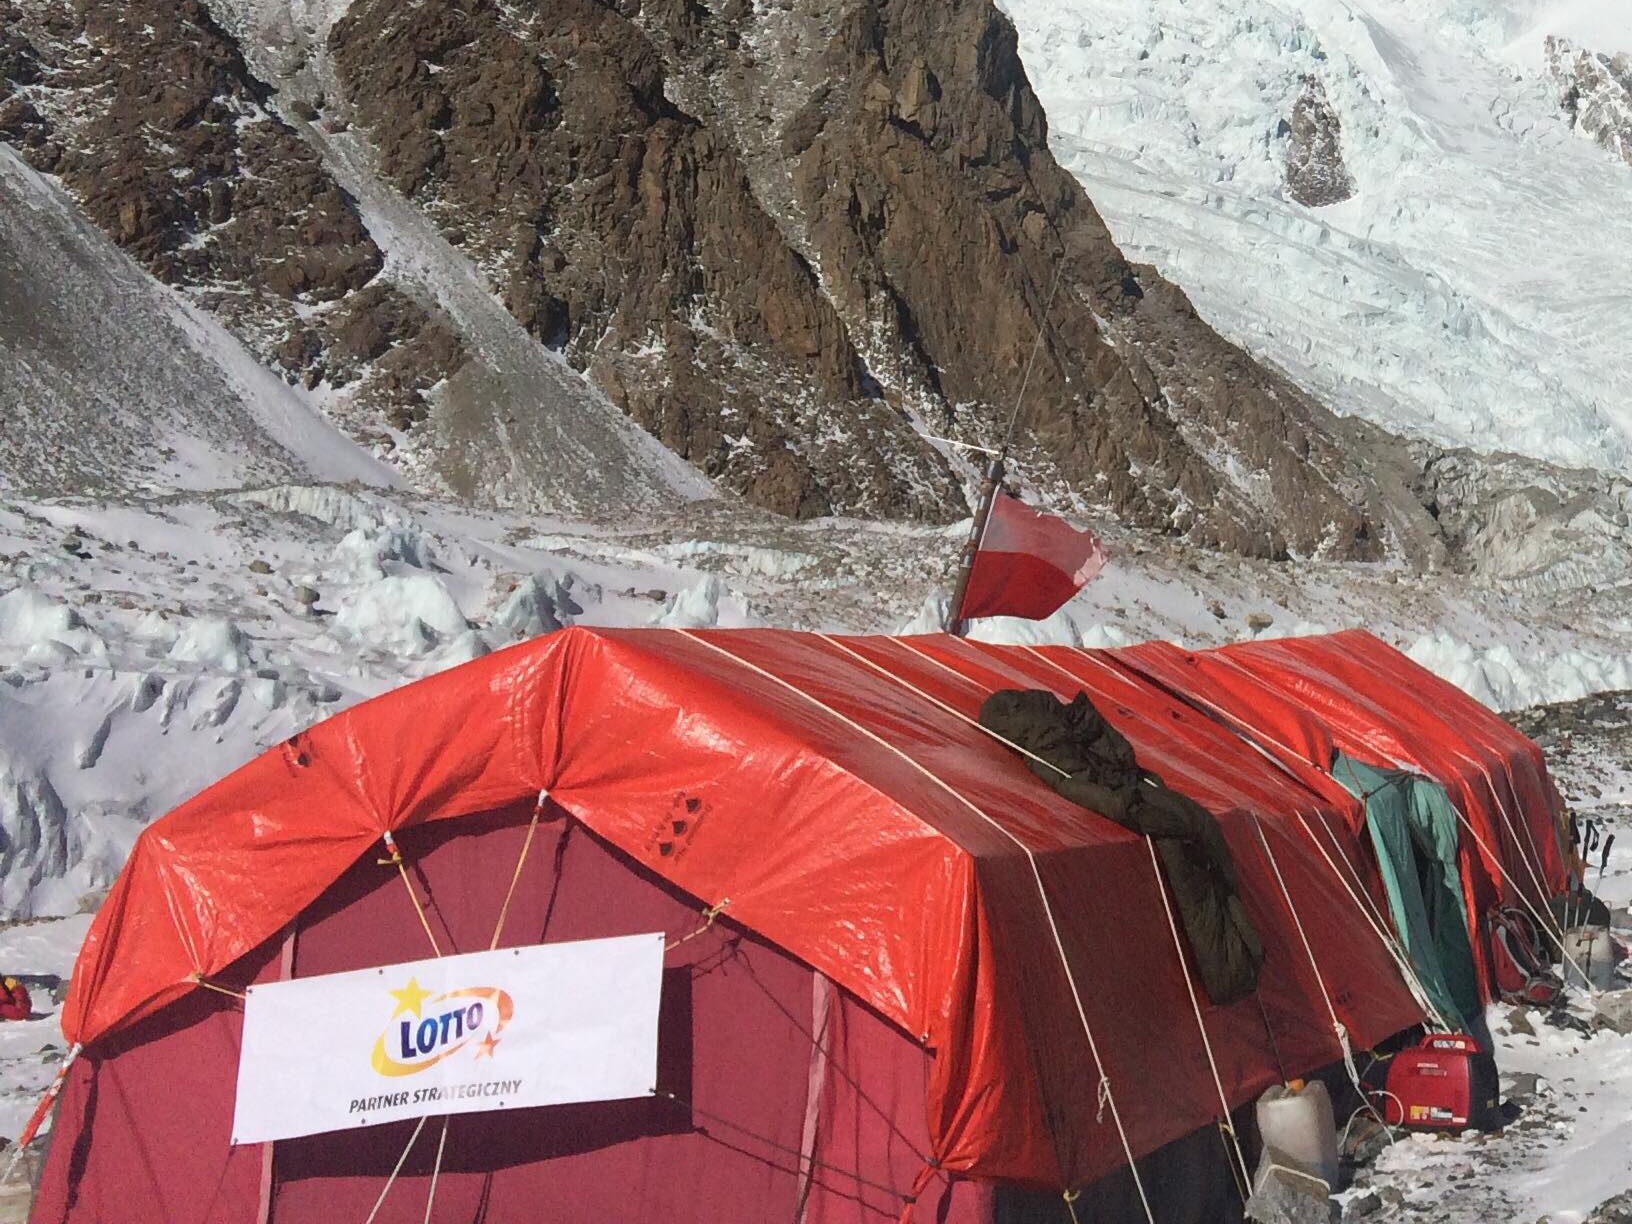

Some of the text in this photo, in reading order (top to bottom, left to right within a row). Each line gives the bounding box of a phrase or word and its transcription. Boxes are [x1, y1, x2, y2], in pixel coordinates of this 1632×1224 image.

[401, 1002, 483, 1058] LOTTO
[349, 1079, 522, 1113] PARTNER STRATEGICZNY
